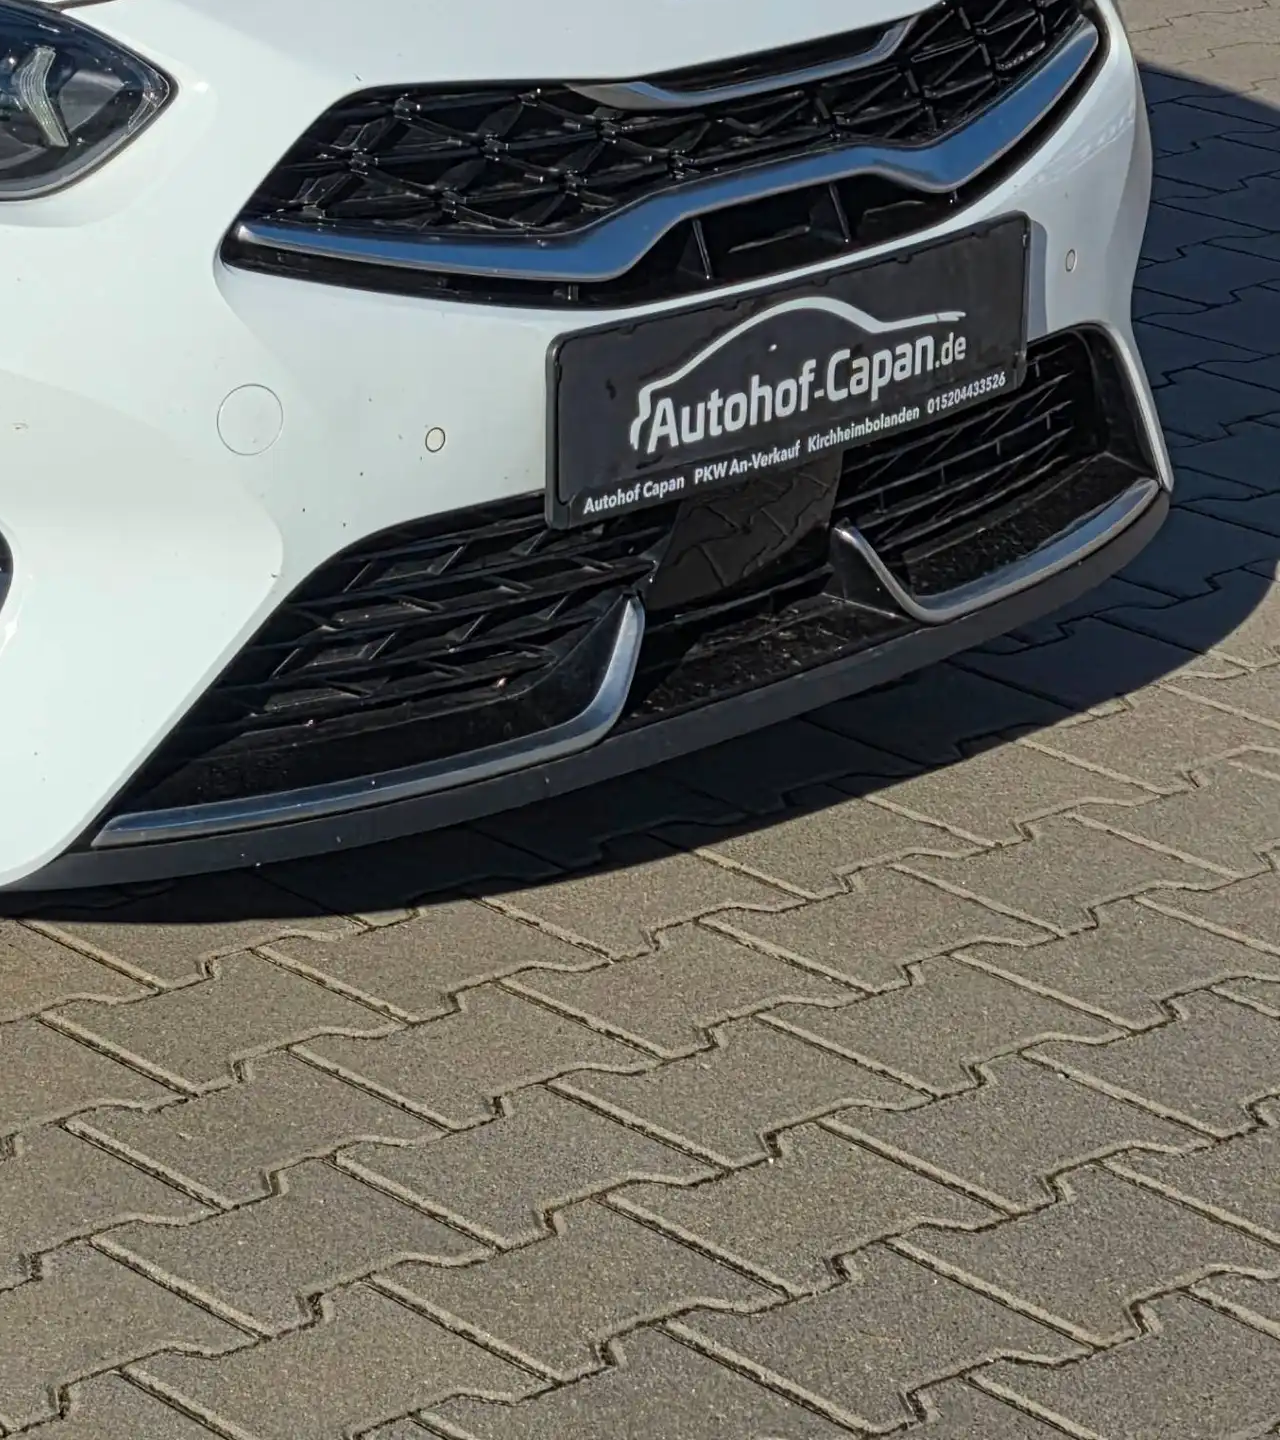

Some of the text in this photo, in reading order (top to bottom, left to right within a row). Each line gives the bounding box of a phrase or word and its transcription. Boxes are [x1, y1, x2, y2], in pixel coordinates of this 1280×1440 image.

[646, 332, 966, 453] Autohof-Capan.de
[583, 486, 641, 515] Autohof
[643, 475, 685, 499] Capan
[694, 461, 728, 485] PKW
[729, 439, 801, 476] An-Verkauf
[807, 406, 920, 453] Kirchheimbolanden
